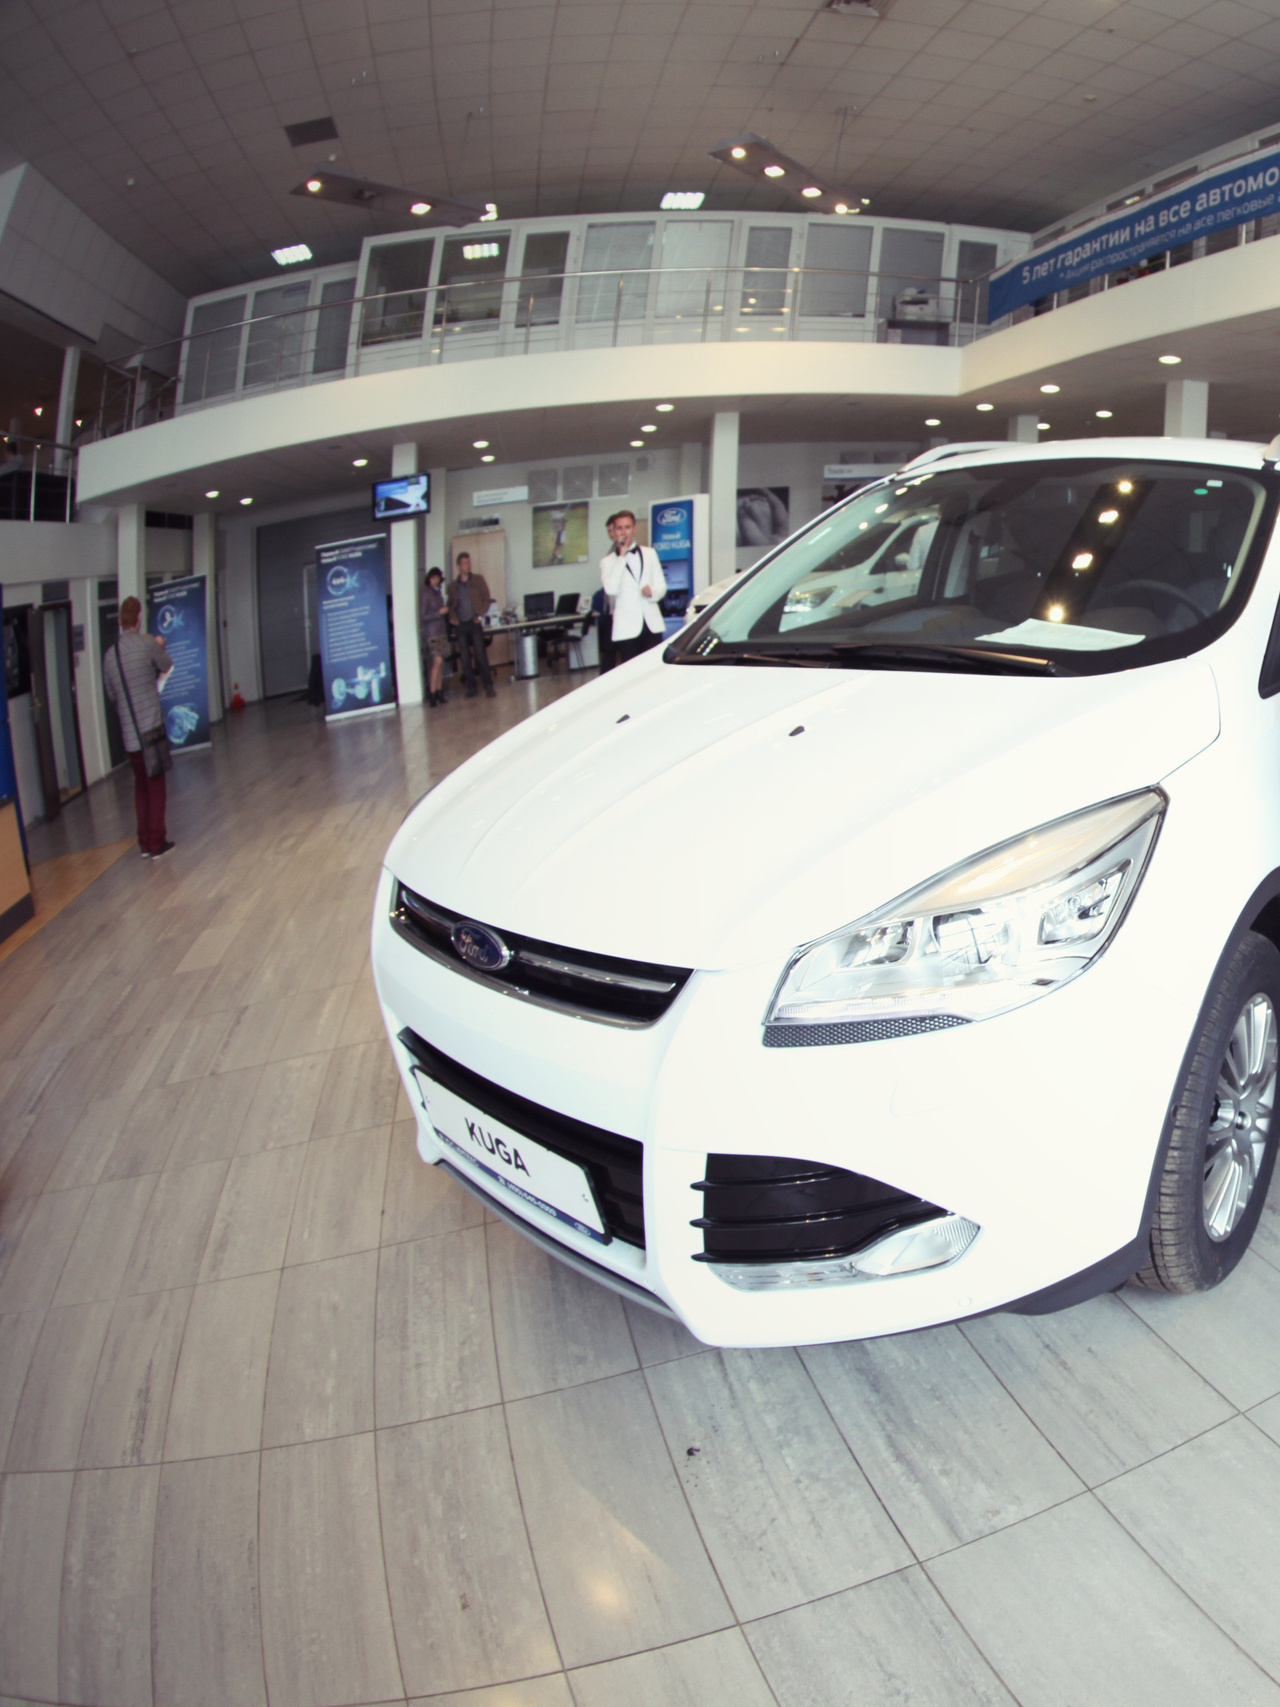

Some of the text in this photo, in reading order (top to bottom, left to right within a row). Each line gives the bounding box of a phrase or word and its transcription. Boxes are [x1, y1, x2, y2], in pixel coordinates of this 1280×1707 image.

[1177, 222, 1192, 238] на
[1193, 214, 1214, 231] все
[1216, 192, 1275, 223] легковые
[1022, 266, 1031, 285] 5
[1032, 257, 1056, 281] лет
[1056, 226, 1130, 268] гарантии
[1134, 214, 1156, 239] на
[1158, 200, 1191, 227] все
[461, 928, 489, 963] Ford
[464, 1117, 531, 1178] KUGA
